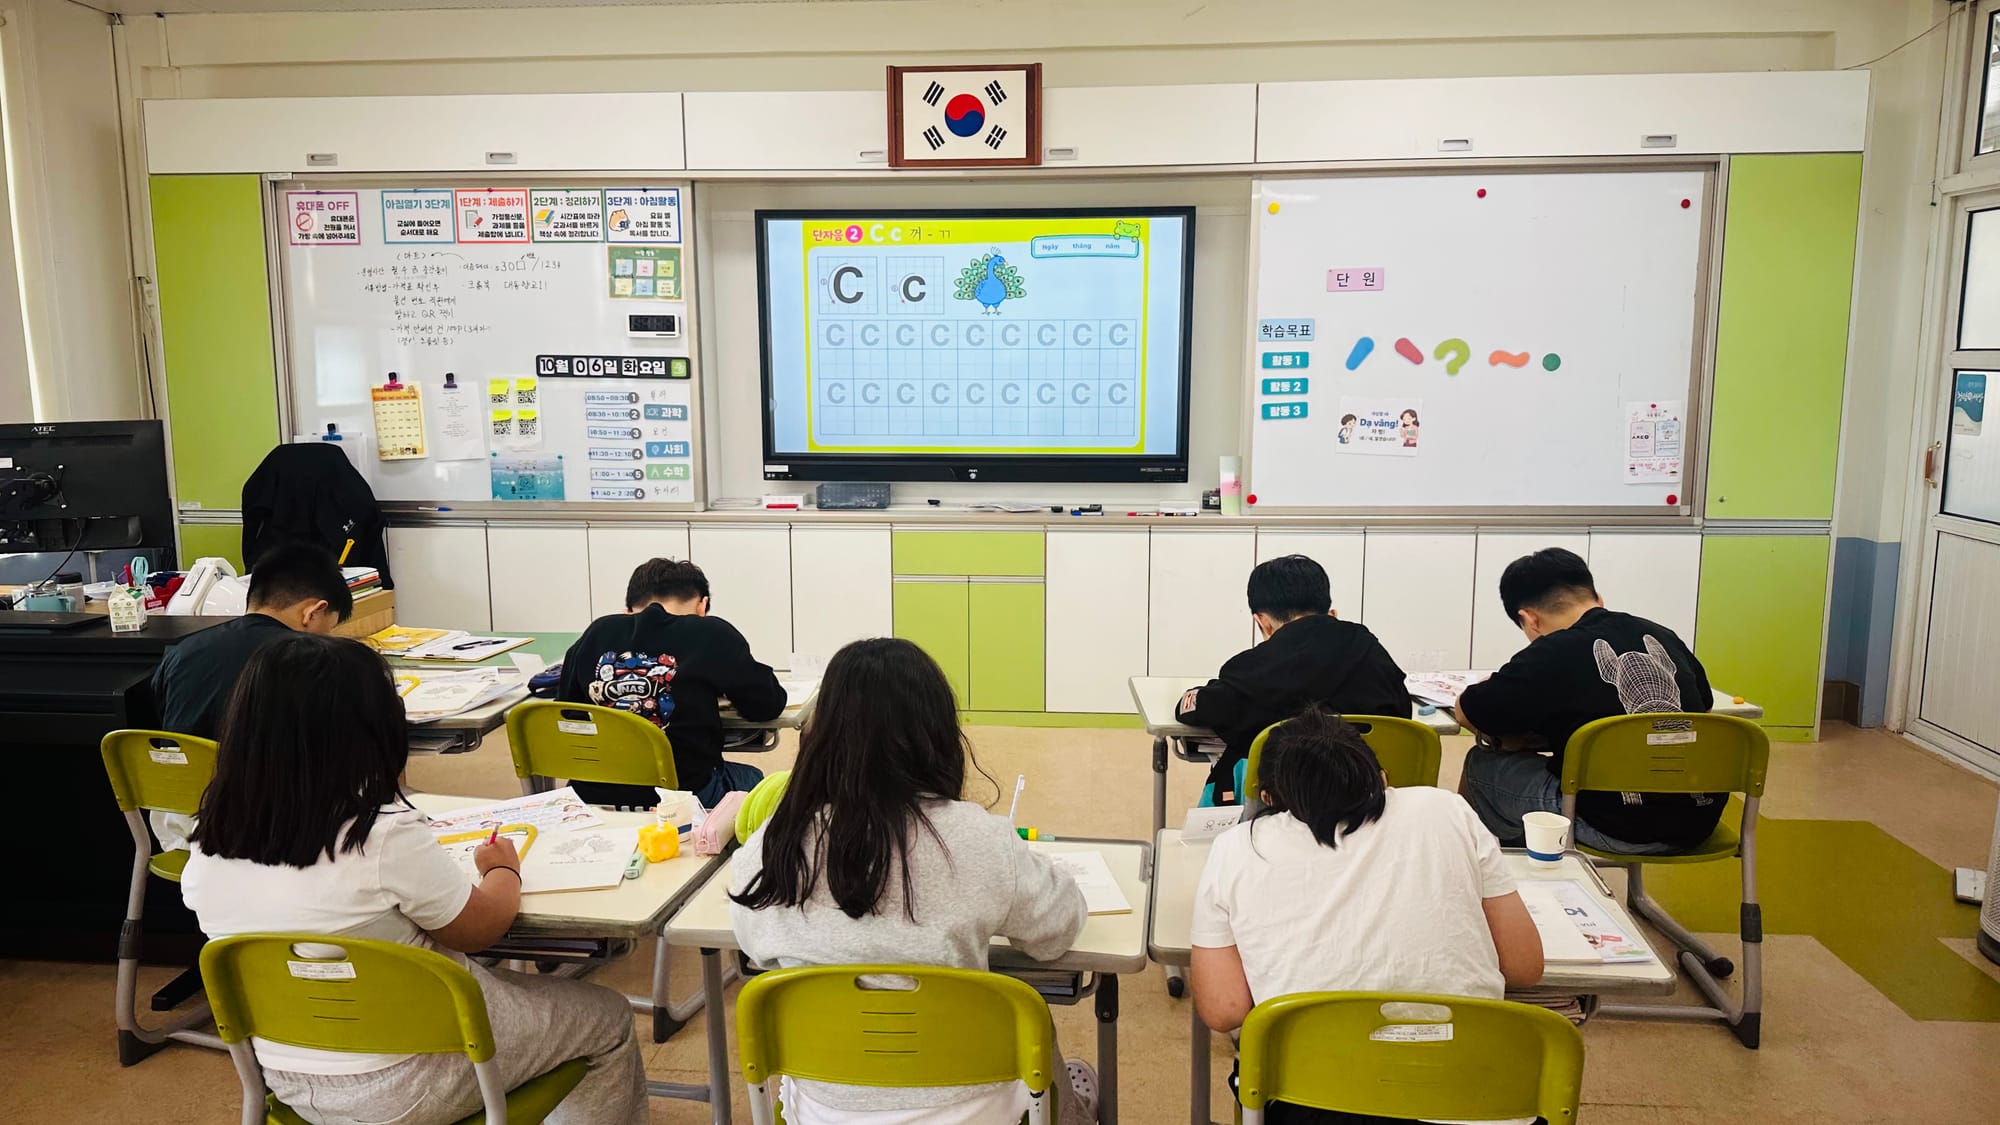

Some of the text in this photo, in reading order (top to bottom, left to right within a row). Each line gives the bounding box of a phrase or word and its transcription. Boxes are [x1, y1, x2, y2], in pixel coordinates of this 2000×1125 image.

[296, 201, 350, 211] 휴대폰 OFF
[385, 199, 450, 210] 아침열기 3단계
[459, 197, 481, 207] 1단계
[488, 197, 524, 207] 제출하기
[534, 197, 558, 206] 2단계
[565, 197, 600, 206] 정리하기
[607, 197, 632, 206] 3단계
[639, 196, 677, 206] 아침활동
[812, 228, 858, 242] 단자음 2
[870, 224, 885, 242] C
[833, 266, 864, 303] C
[1262, 324, 1311, 338] 학습목표
[1272, 355, 1301, 366] 활동 1
[540, 358, 569, 374] 10월
[623, 359, 666, 376] 화요일
[1270, 381, 1301, 392] 활동 2
[661, 407, 682, 418] 과학
[1270, 406, 1301, 417] 활동 3
[663, 444, 684, 455] 사회
[663, 466, 684, 477] 수학
